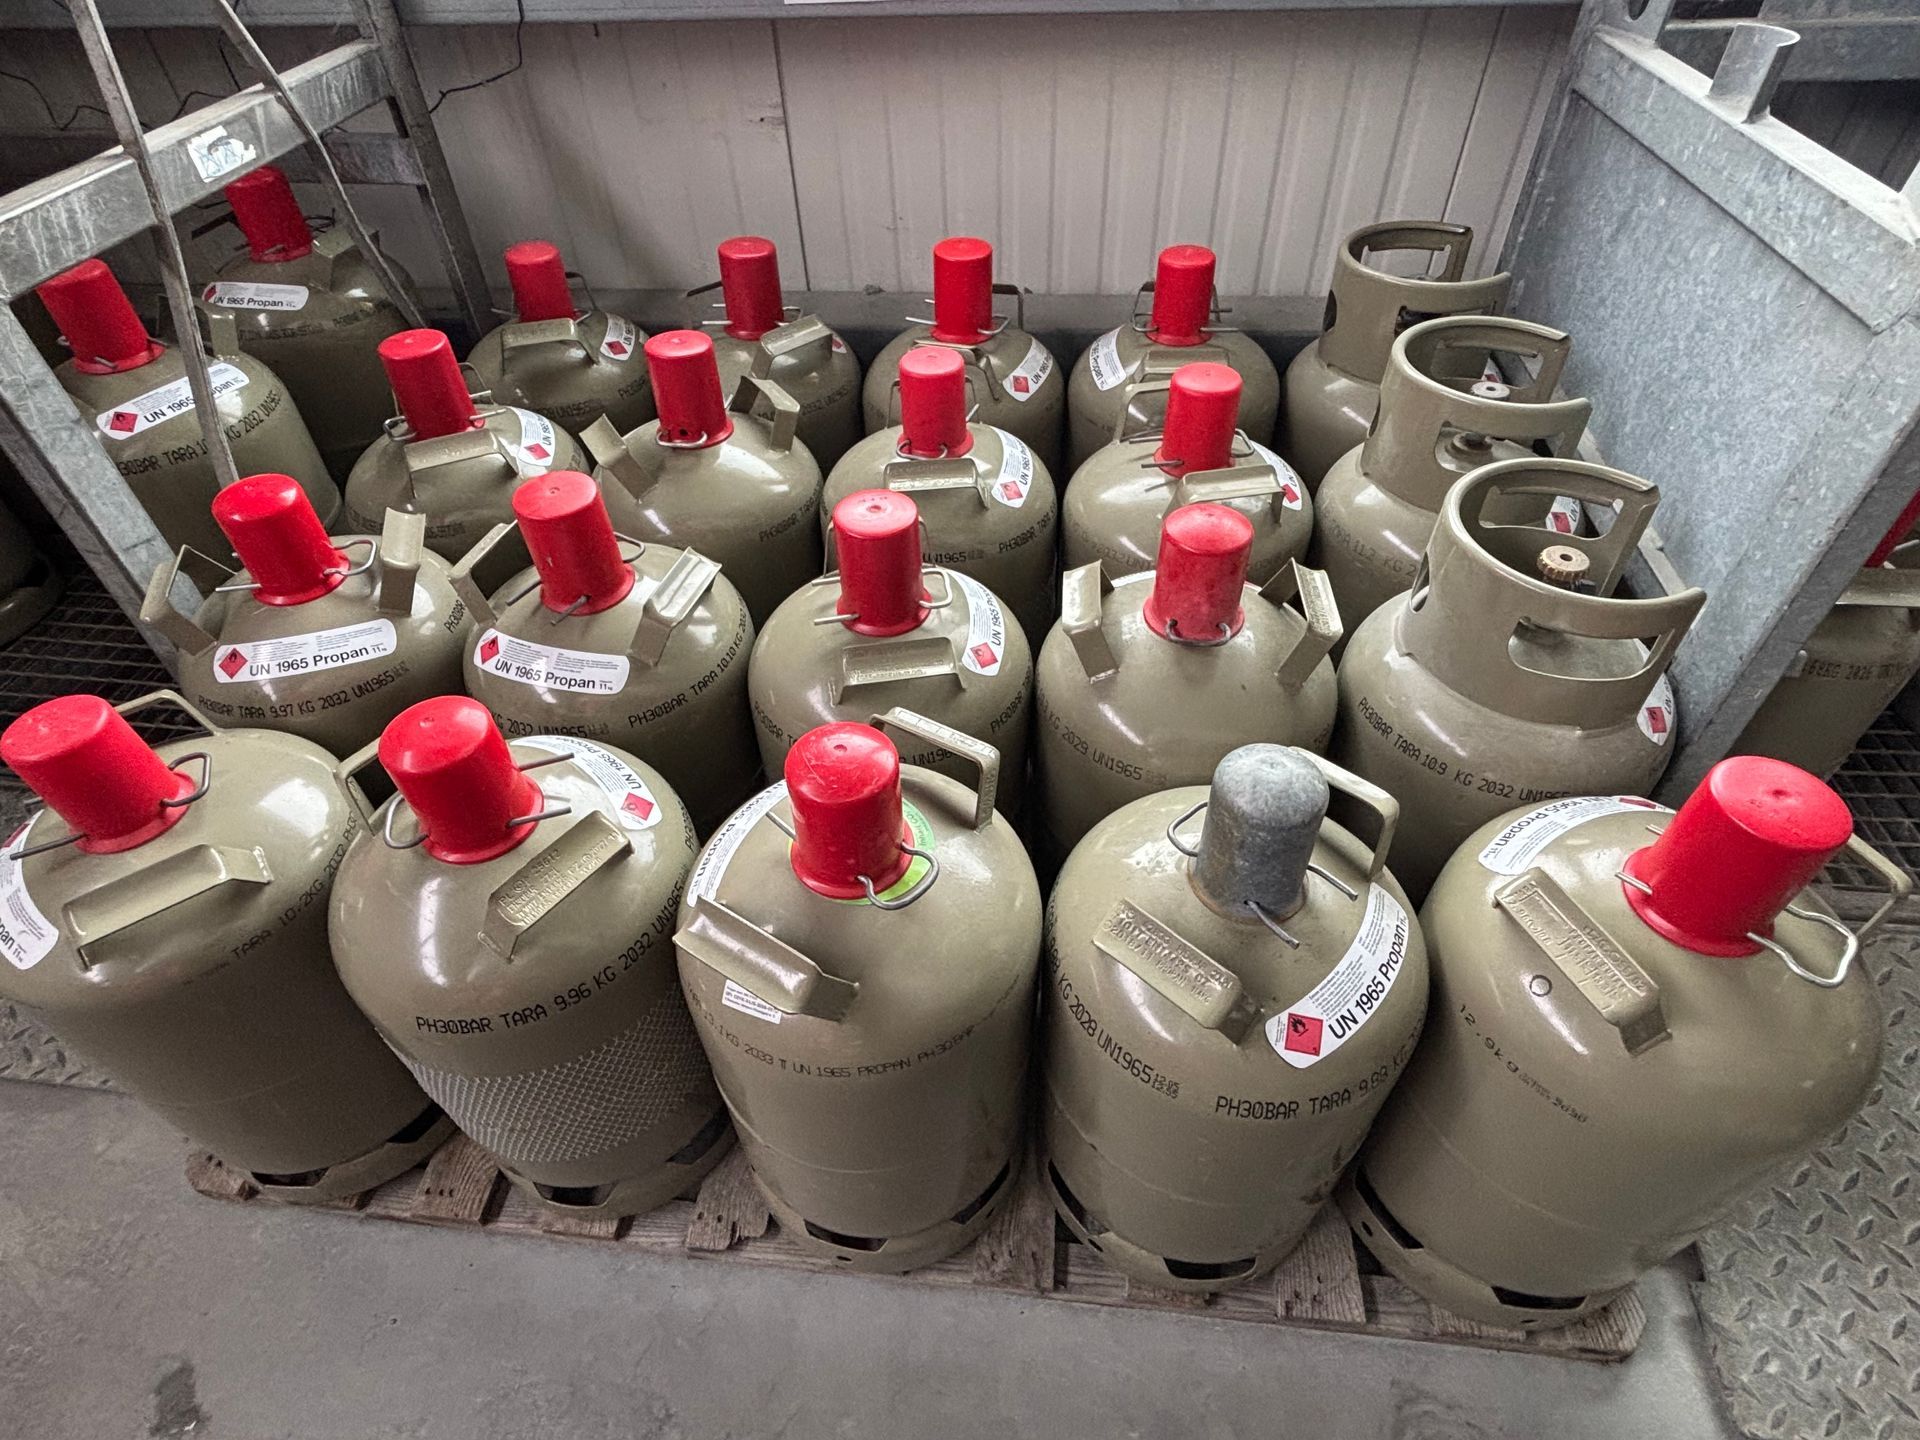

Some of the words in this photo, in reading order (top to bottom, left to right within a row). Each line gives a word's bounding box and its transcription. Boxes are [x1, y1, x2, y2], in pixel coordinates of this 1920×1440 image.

[226, 297, 245, 306] 1965
[247, 298, 284, 308] Propan
[1031, 372, 1043, 384] UN
[144, 409, 167, 423] UN
[167, 397, 196, 413] 1965
[210, 380, 235, 395] pan
[163, 444, 198, 466] TARA
[197, 438, 208, 456] 10
[224, 424, 241, 442] KG
[238, 410, 265, 434] 2032
[1019, 472, 1029, 486] UN
[922, 551, 967, 563] UN1965
[991, 630, 1002, 646] UN
[249, 663, 271, 677] UN
[276, 657, 309, 673] 1965
[313, 646, 370, 668] Propan
[494, 658, 512, 675] UN
[515, 665, 542, 682] 1965
[543, 672, 596, 690] Propan
[239, 705, 266, 719] TARA
[299, 701, 316, 715] KG
[319, 690, 351, 710] 2032
[351, 670, 396, 699] UN1965
[627, 692, 689, 728] PH30BAR
[689, 670, 719, 696] TARA
[733, 632, 744, 652] KG
[507, 718, 534, 736] 2032
[600, 753, 622, 772] 1965
[1062, 726, 1089, 756] 2029
[1093, 747, 1143, 780] UN1965
[1358, 696, 1393, 741] PH30BAR
[1393, 733, 1422, 762] TARA
[1454, 769, 1474, 787] KG
[1478, 777, 1515, 799] 2032
[622, 773, 642, 790] UN
[1547, 799, 1583, 814] 1965
[1494, 812, 1548, 847] Propan
[697, 823, 736, 877] Propan
[231, 930, 272, 958] TARA
[278, 879, 325, 927] 10.2KG
[415, 1014, 495, 1034] PH30BAR
[499, 1003, 549, 1029] TARA
[554, 982, 593, 1012] 9.96
[593, 965, 617, 991] KG
[618, 932, 655, 972] 2032
[652, 879, 685, 935] UN1965
[1328, 1008, 1359, 1040] UN
[1355, 975, 1386, 1016] 1965
[1378, 923, 1406, 982] Propan
[1057, 973, 1072, 1000] KG
[1069, 994, 1098, 1037] 2028
[1097, 1029, 1154, 1084] UN1965
[745, 1045, 775, 1066] 2033
[792, 1062, 812, 1077] UN
[816, 1066, 851, 1078] 1965
[857, 1057, 912, 1078] PROPAN
[1215, 1095, 1299, 1120] PH30BAR
[1309, 1087, 1351, 1115] TARA
